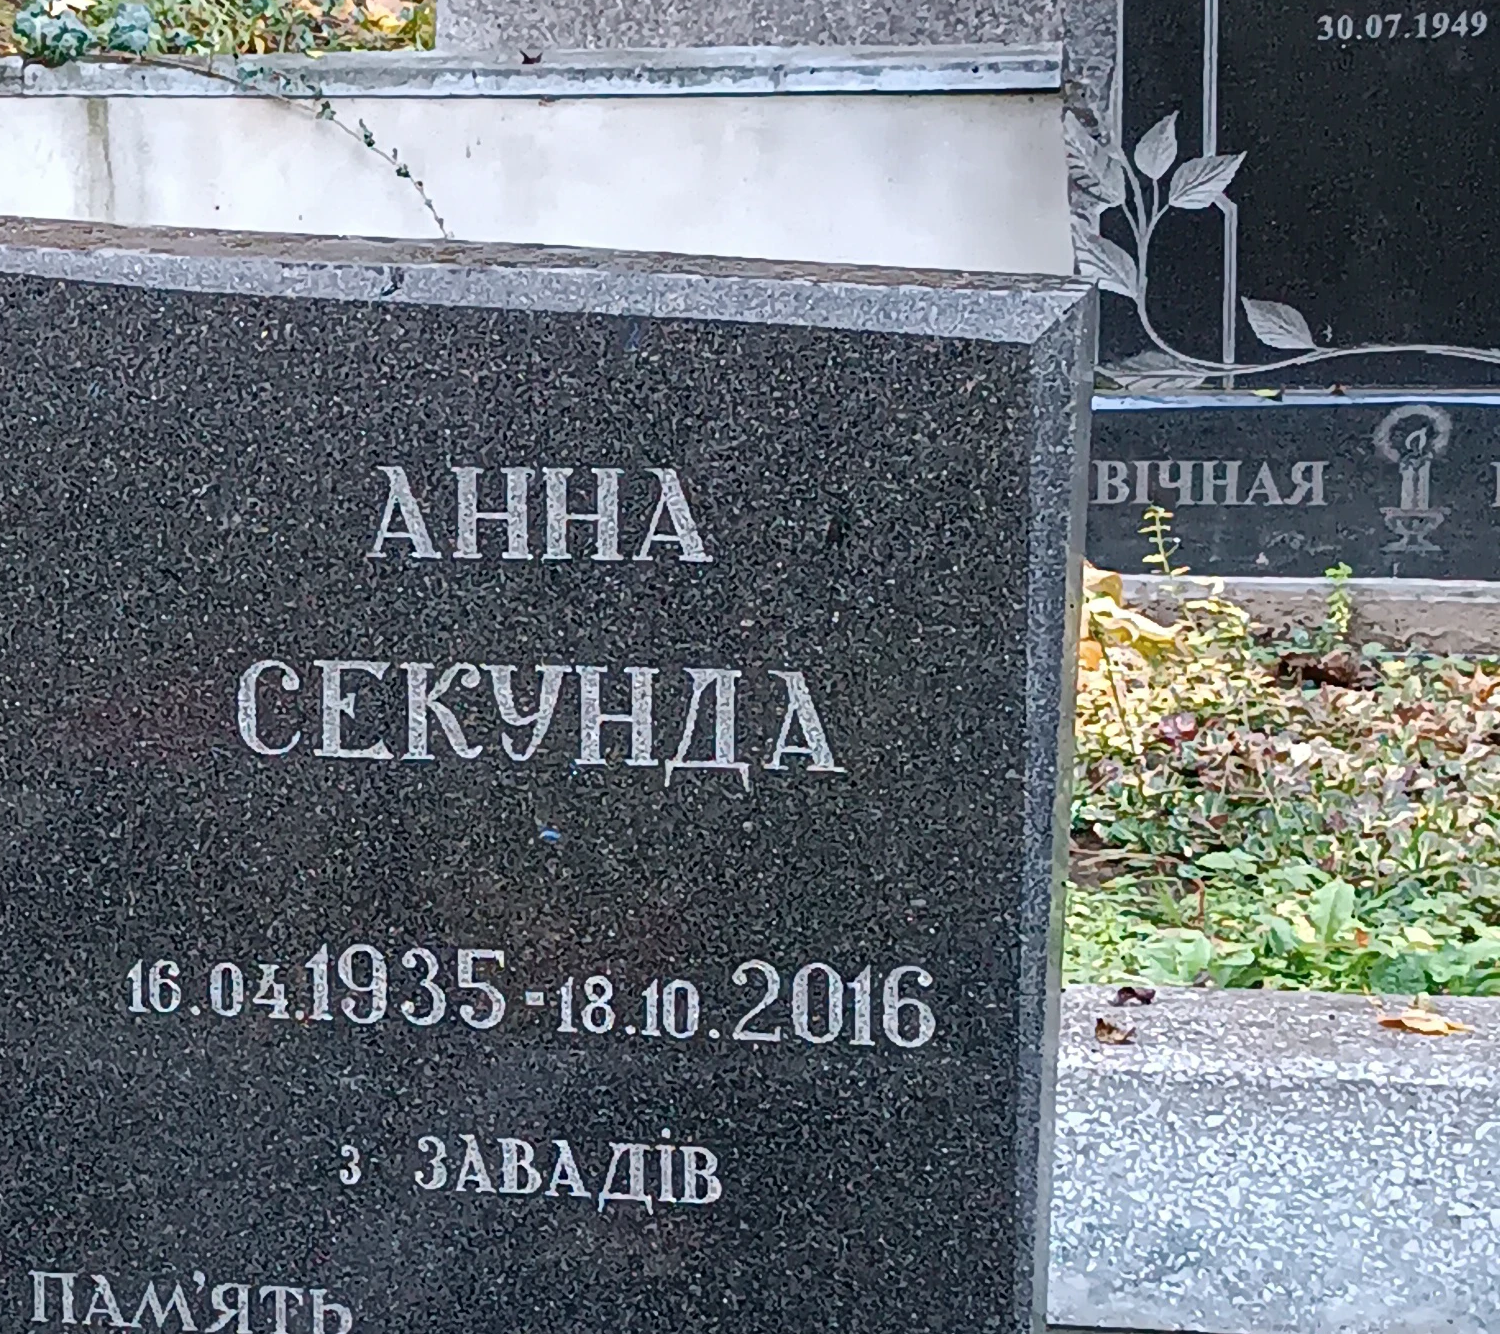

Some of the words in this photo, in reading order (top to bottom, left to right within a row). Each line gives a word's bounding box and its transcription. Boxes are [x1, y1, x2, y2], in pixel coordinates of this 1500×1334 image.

[1316, 9, 1488, 41] 30.07.1949
[367, 466, 713, 564] АННА
[1088, 459, 1329, 507] ВІЧНАЯ
[236, 658, 846, 792] СЕКУНДА
